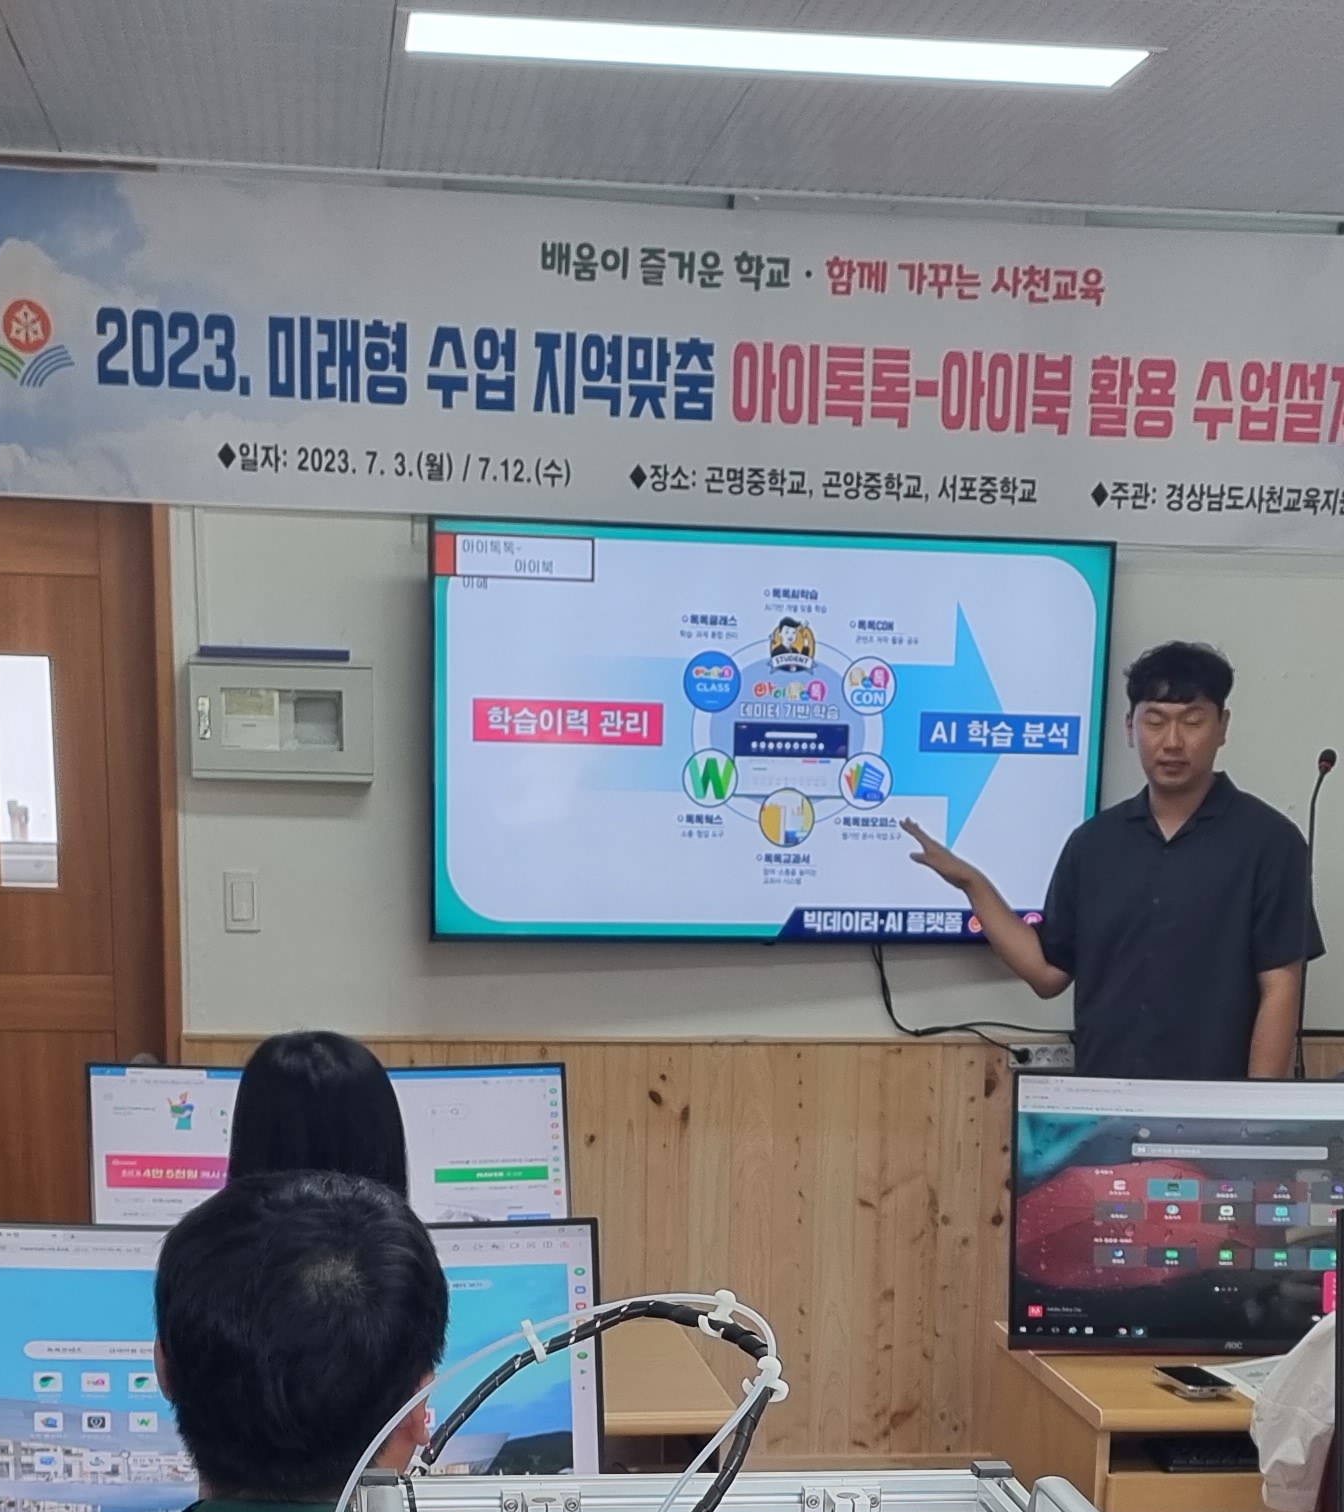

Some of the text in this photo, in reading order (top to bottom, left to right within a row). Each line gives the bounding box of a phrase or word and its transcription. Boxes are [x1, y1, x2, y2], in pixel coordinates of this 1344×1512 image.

[541, 241, 630, 282] 배움이
[639, 248, 723, 289] 즐거운
[734, 251, 791, 290] 학교
[826, 256, 887, 296] 함께
[899, 261, 981, 301] 가꾸는
[992, 265, 1105, 306] 사천교육
[96, 306, 250, 396] 2023.
[268, 314, 407, 406] 미래형
[427, 324, 517, 413] 수업
[533, 331, 715, 423] 지역맞춤
[732, 340, 1073, 436] 아이톡톡-아이북
[1089, 356, 1176, 440] 활용
[238, 444, 288, 472] 일자:
[297, 447, 358, 476] 2023.
[365, 451, 382, 476] 7.
[478, 457, 572, 488] 7.12.(수)
[649, 464, 1037, 506] 장소: 곤명중학교, 곤양중학교, 서포중학교
[1110, 483, 1157, 509] 주관:
[515, 559, 553, 574] 아이북
[775, 654, 810, 665] STUDENT
[696, 682, 730, 692] CLASS
[852, 690, 886, 706] CON
[488, 706, 648, 738] 학습이력 관리
[740, 703, 839, 720] 데이터 기반 학습
[930, 720, 1069, 748] AI 학습 분석
[906, 912, 963, 934] 플랫폼
[1225, 1341, 1242, 1349] AOC
